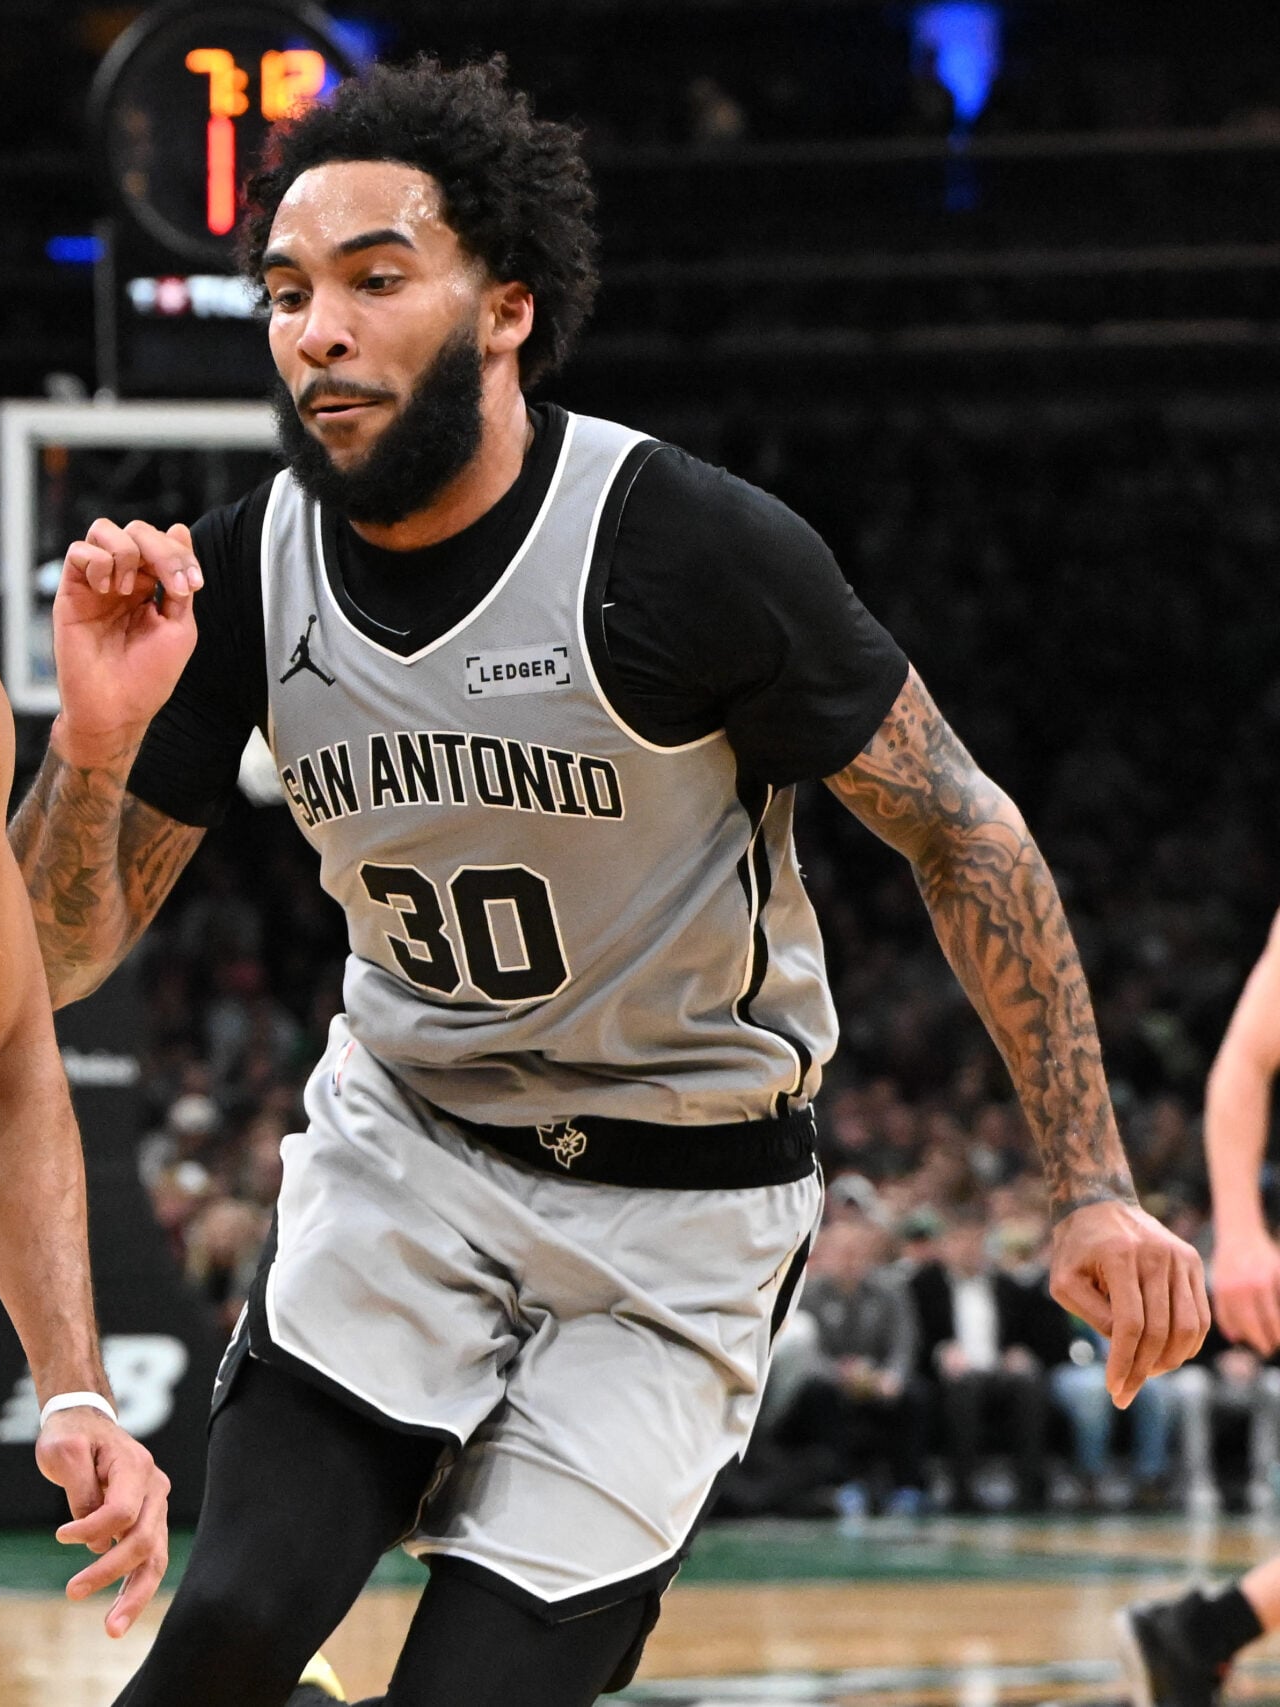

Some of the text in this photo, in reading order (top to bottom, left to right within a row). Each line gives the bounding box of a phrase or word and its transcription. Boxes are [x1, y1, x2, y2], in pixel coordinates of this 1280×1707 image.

[480, 659, 556, 682] LEDGER
[282, 731, 625, 828] SAN ANTONIO
[357, 860, 571, 1005] 30
